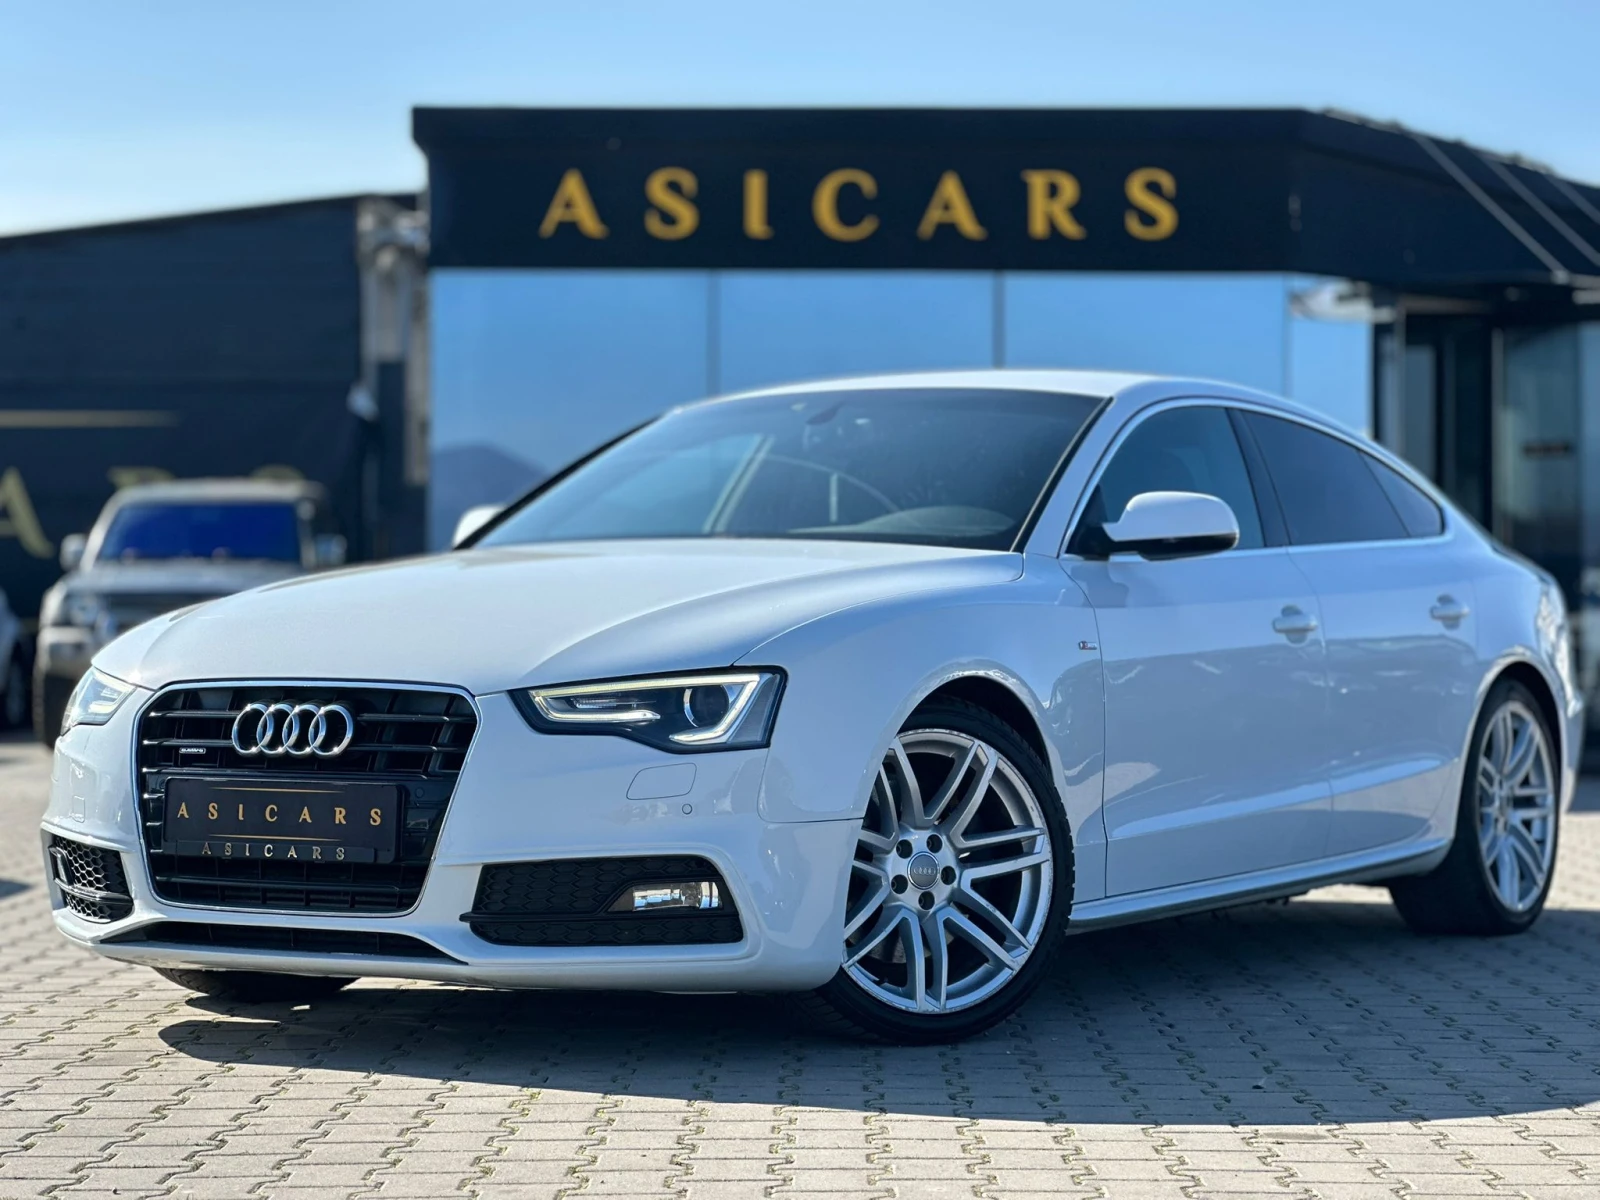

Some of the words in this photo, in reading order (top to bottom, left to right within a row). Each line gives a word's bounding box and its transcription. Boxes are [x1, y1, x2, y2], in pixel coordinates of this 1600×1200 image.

[538, 166, 1179, 242] ASICARS
[176, 802, 382, 826] ASICARS
[201, 842, 345, 861] ASICARS
